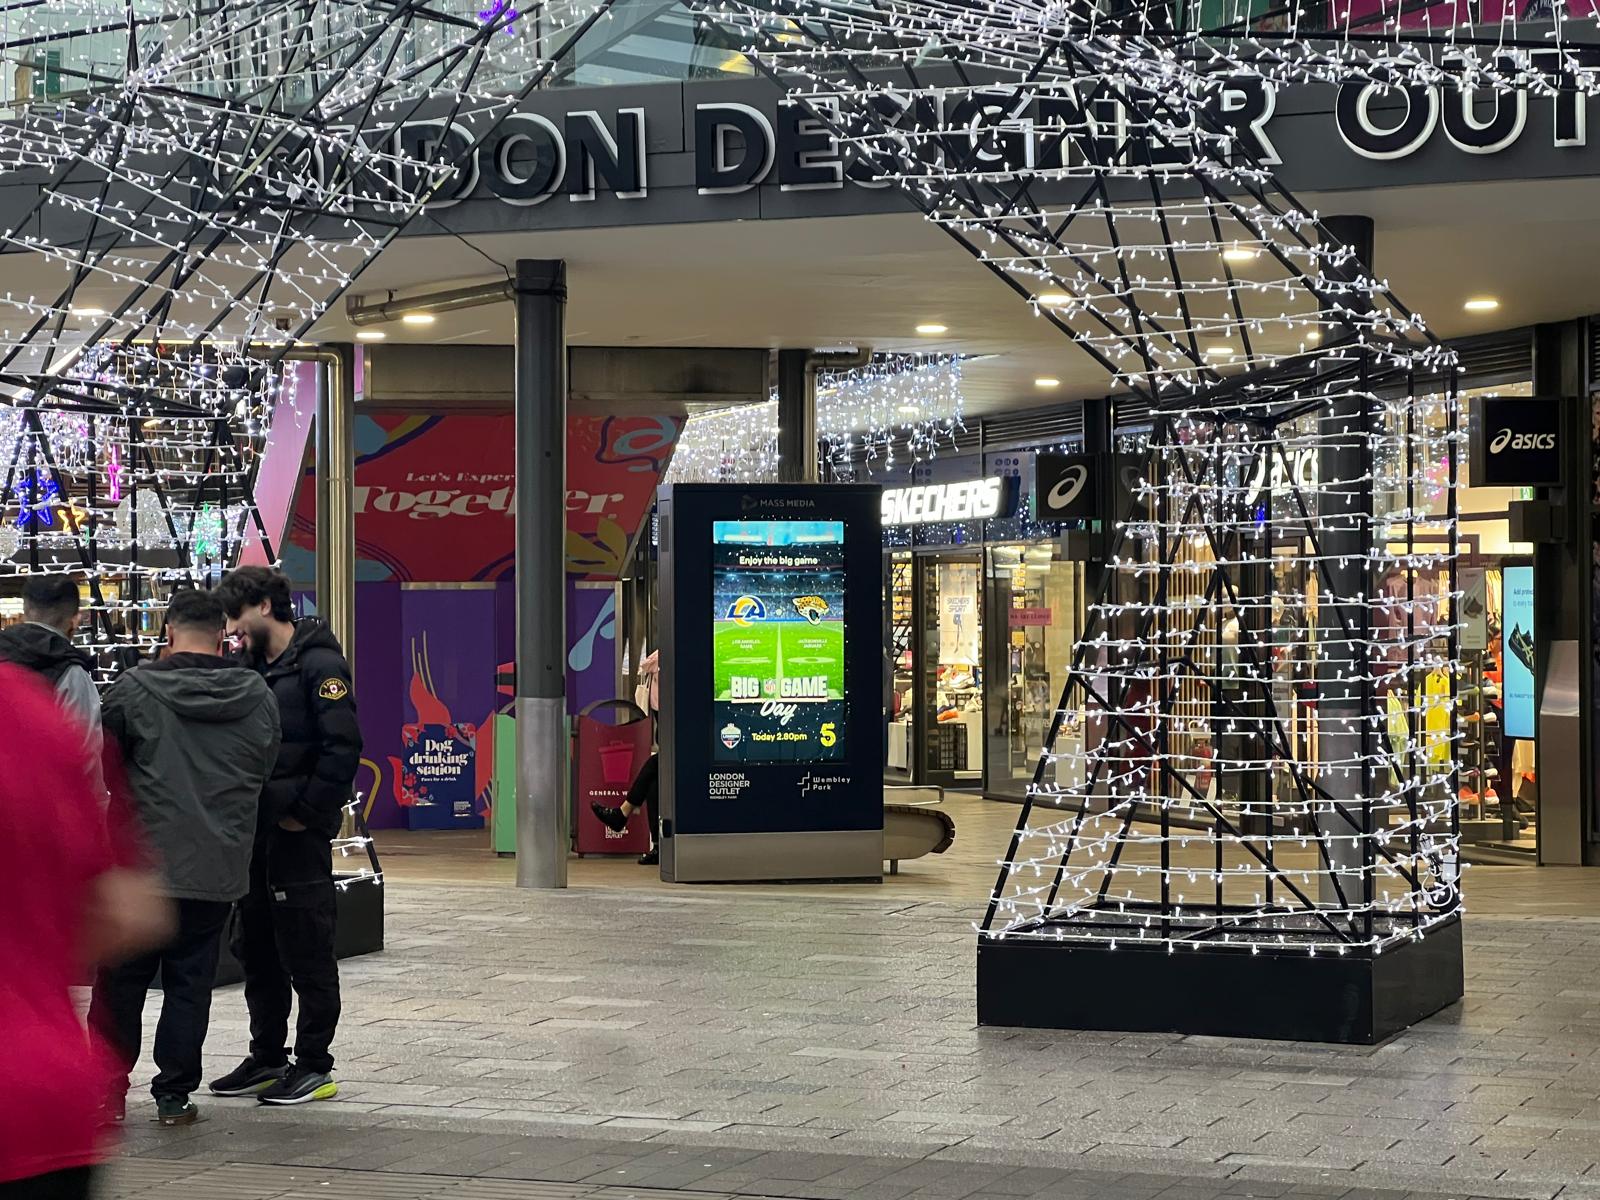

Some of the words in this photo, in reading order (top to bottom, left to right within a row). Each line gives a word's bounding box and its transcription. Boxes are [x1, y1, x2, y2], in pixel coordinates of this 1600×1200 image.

[1511, 433, 1556, 450] asics
[406, 472, 451, 481] Let's
[353, 486, 624, 520] Togeter
[760, 499, 785, 507] MASS
[786, 499, 815, 508] MEDIA
[880, 476, 1001, 525] SKECHERS
[739, 555, 762, 566] Enjoy
[764, 555, 778, 565] the
[779, 555, 793, 566] big
[794, 556, 818, 566] game
[731, 676, 759, 698] BIG
[780, 676, 828, 698] GAME
[760, 700, 797, 726] Day
[752, 731, 776, 742] Today
[820, 722, 836, 747] 5
[425, 739, 453, 752] Dog
[409, 752, 468, 765] drinking
[416, 764, 461, 775] station
[709, 780, 750, 788] DESIGNER
[709, 787, 740, 795] OUTLET
